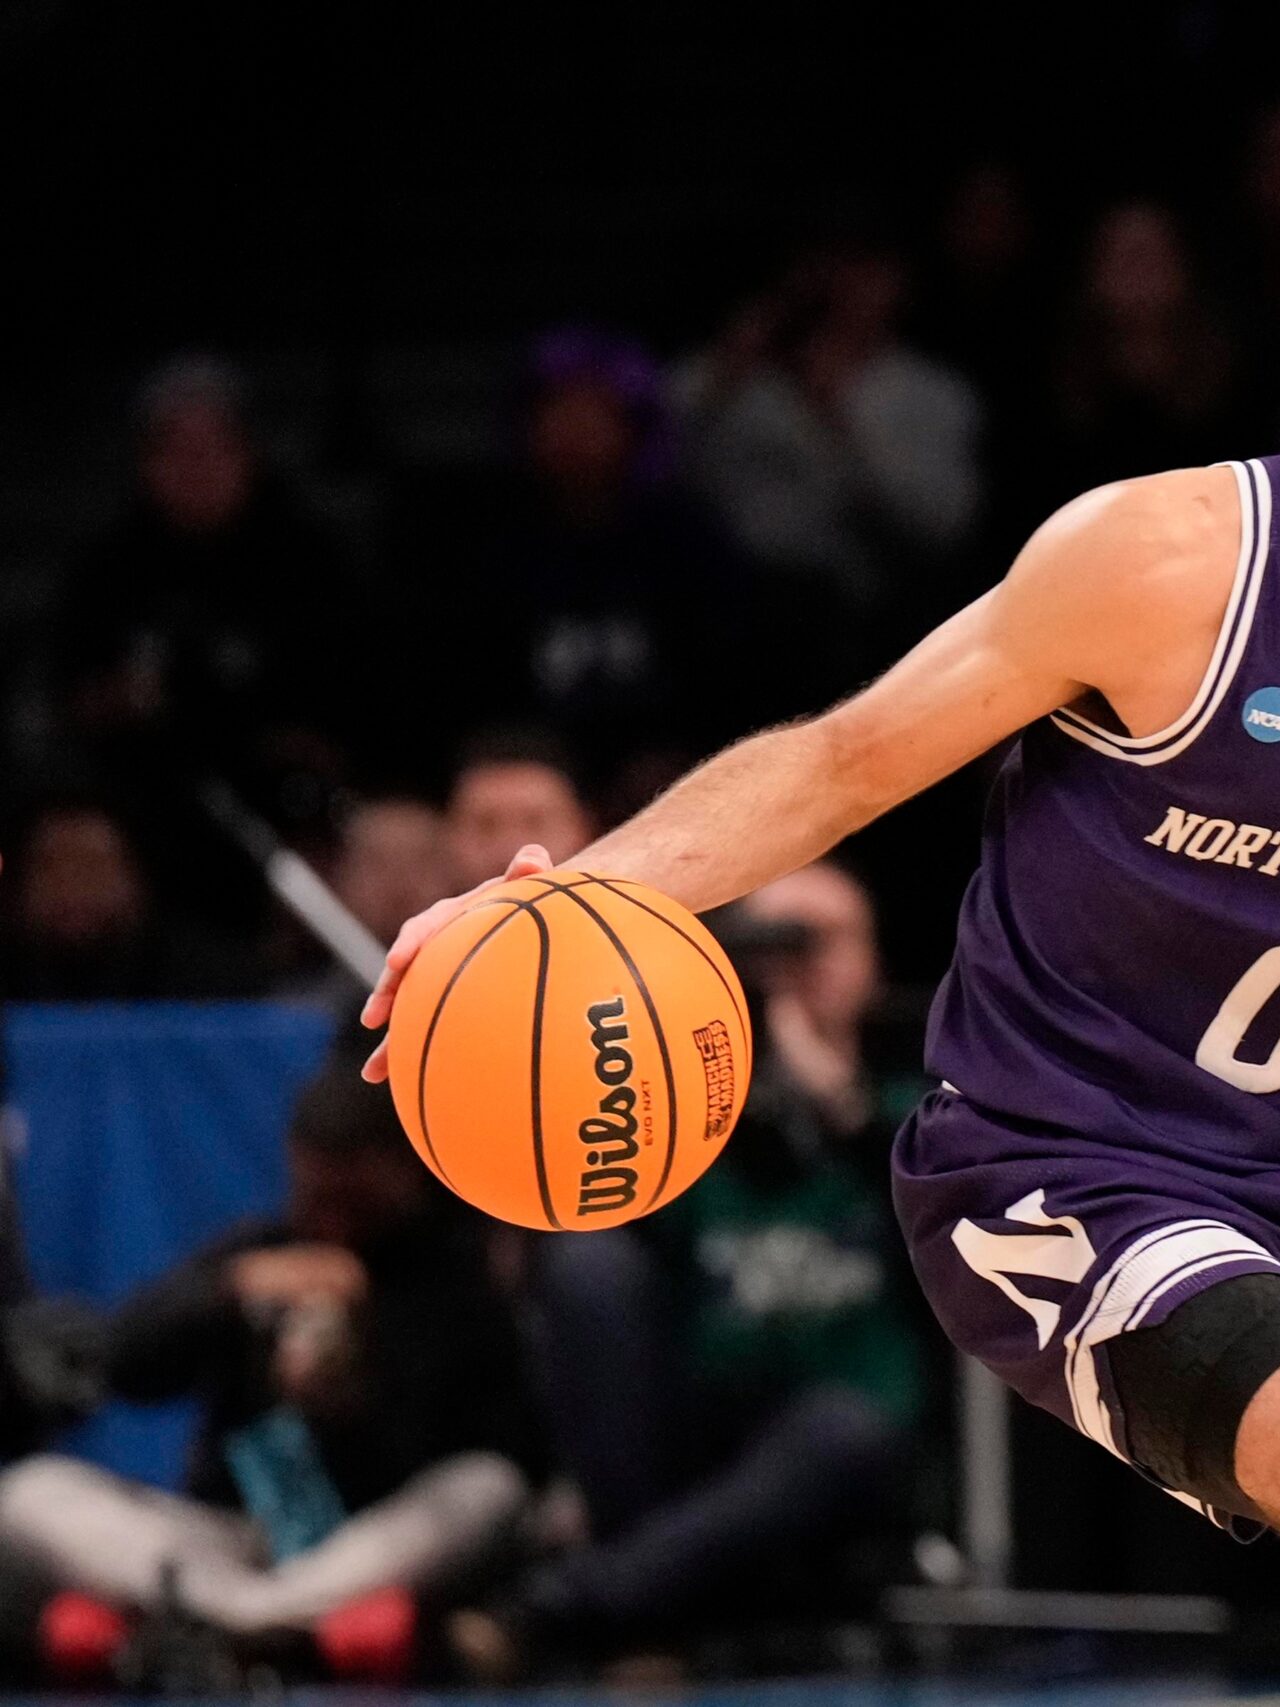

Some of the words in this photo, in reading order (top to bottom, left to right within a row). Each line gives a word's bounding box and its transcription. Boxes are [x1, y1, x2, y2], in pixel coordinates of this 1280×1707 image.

[577, 997, 640, 1216] Wilson
[640, 1079, 652, 1111] NXT
[705, 1057, 721, 1121] MARCH
[643, 1116, 654, 1147] EVO
[950, 1188, 1098, 1351] N
